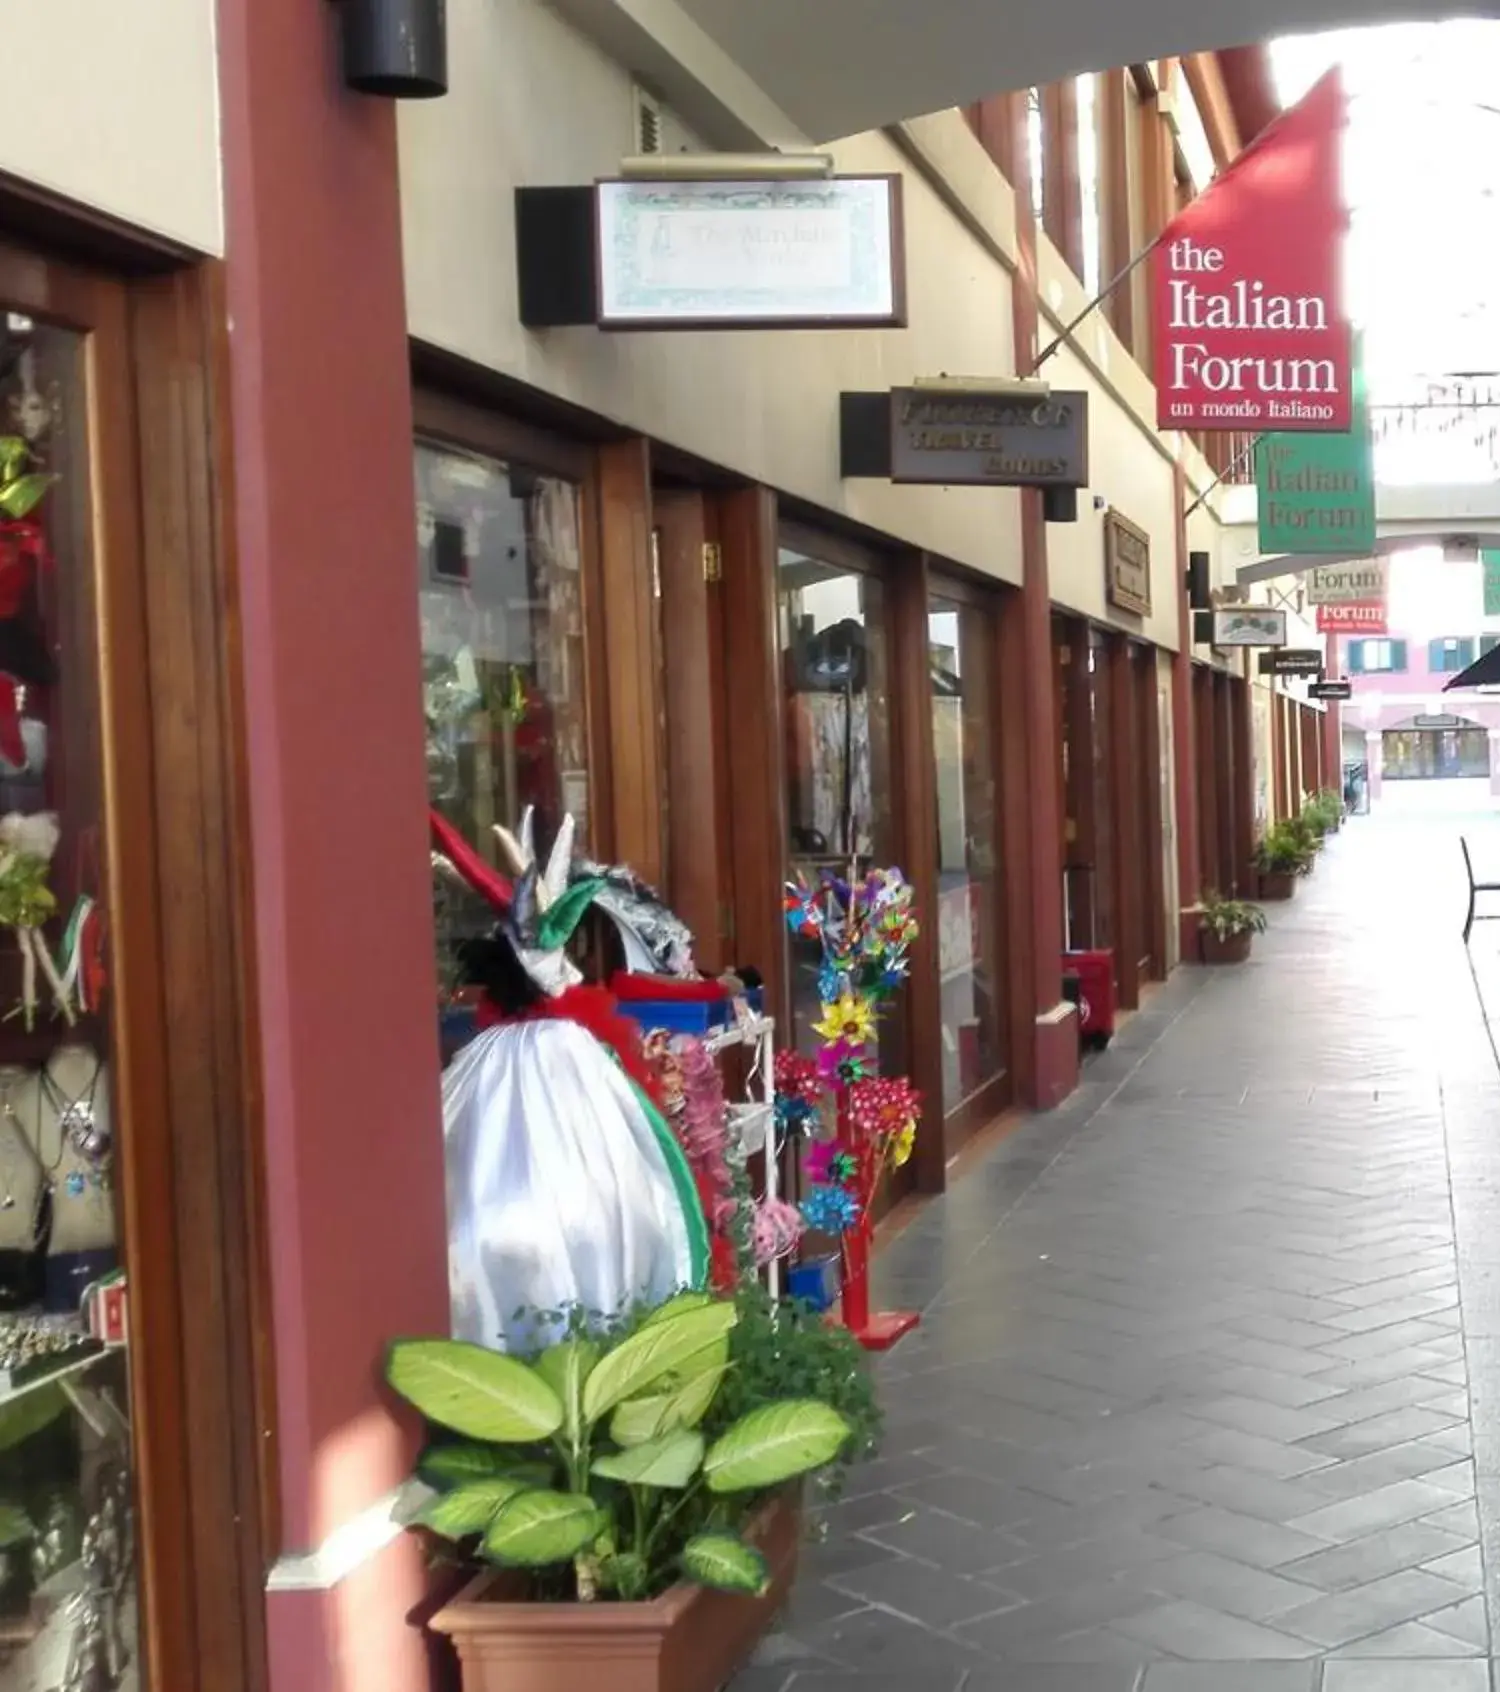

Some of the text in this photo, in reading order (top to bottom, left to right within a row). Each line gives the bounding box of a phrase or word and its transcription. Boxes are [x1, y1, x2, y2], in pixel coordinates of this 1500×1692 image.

[1169, 238, 1225, 272] the
[1168, 279, 1328, 330] Italian
[1169, 342, 1339, 393] Forum
[1169, 399, 1334, 420] un mondo Italiano
[1267, 463, 1359, 492] Italian
[1267, 501, 1367, 530] Forum
[1313, 566, 1383, 590] Forum
[1322, 605, 1384, 621] Forum
